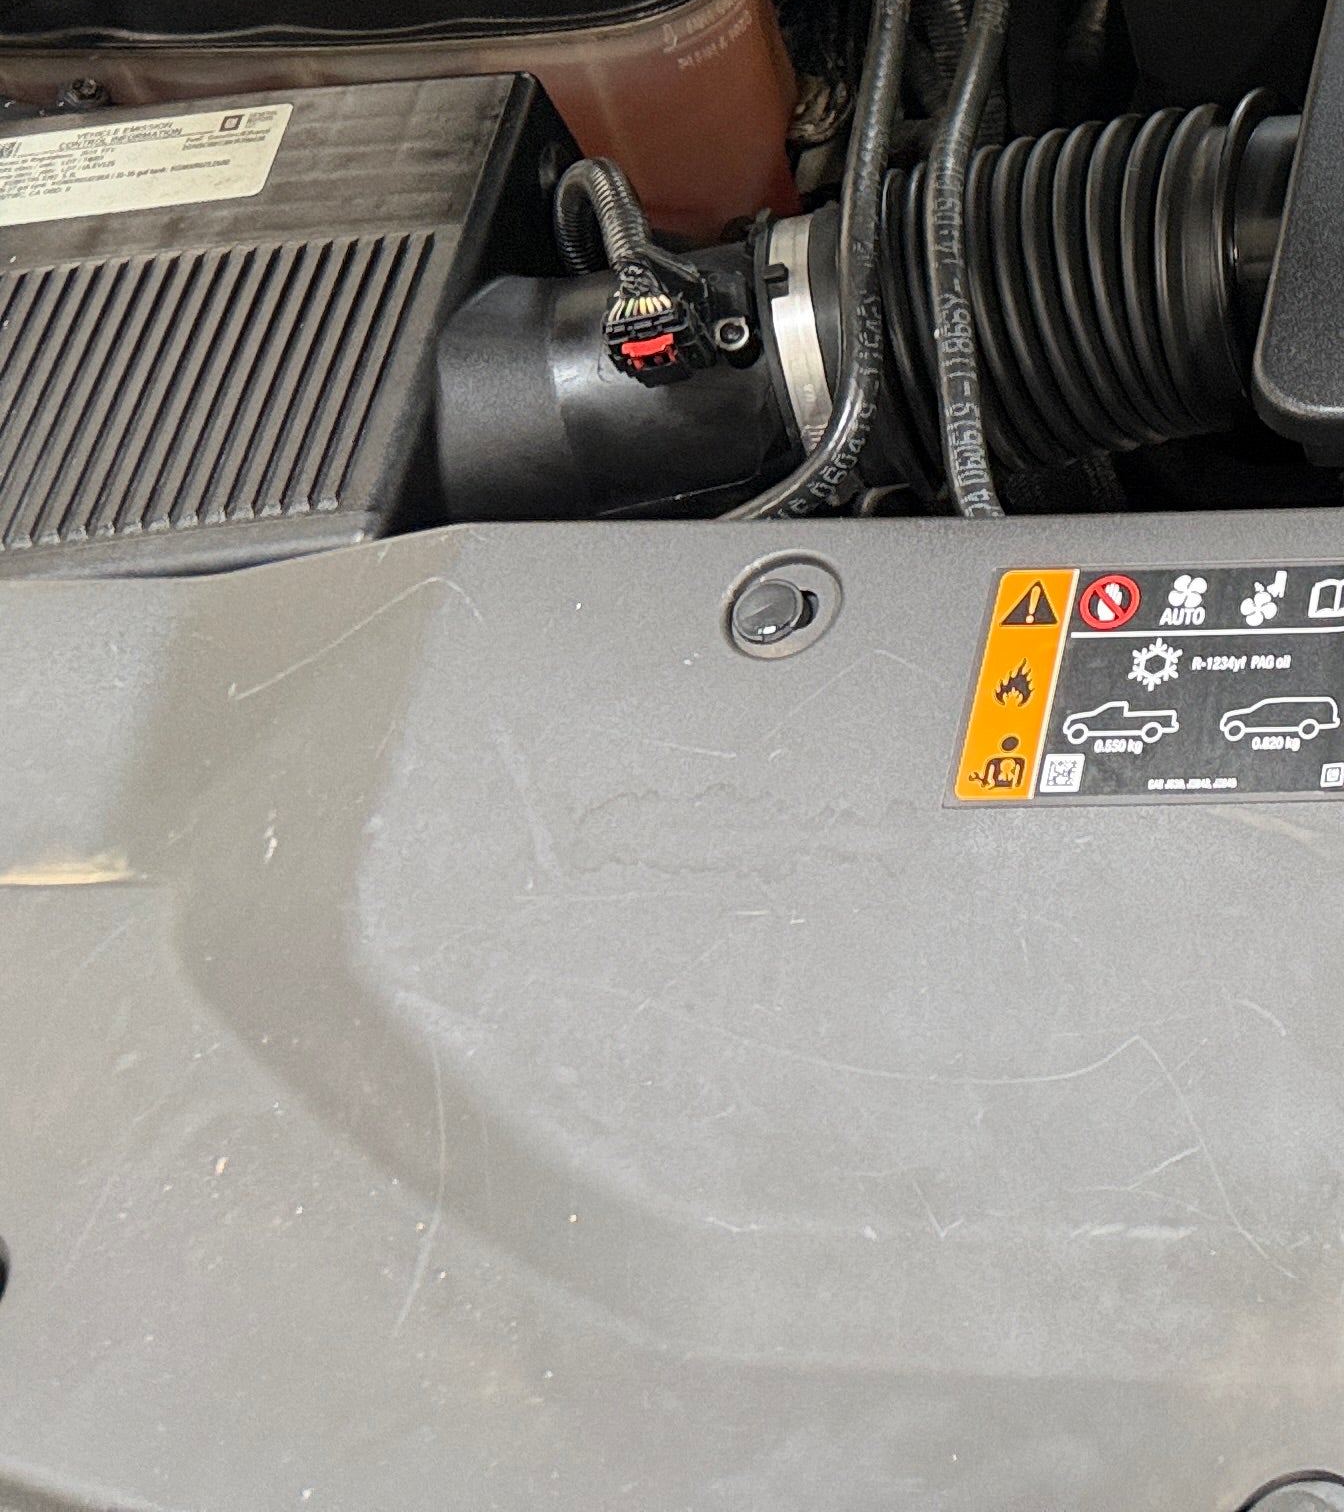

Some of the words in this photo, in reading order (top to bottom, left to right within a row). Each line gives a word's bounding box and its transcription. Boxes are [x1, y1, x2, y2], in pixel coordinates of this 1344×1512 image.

[1159, 607, 1206, 626] AUTO
[1127, 738, 1143, 755] kg
[1282, 735, 1301, 751] kg
